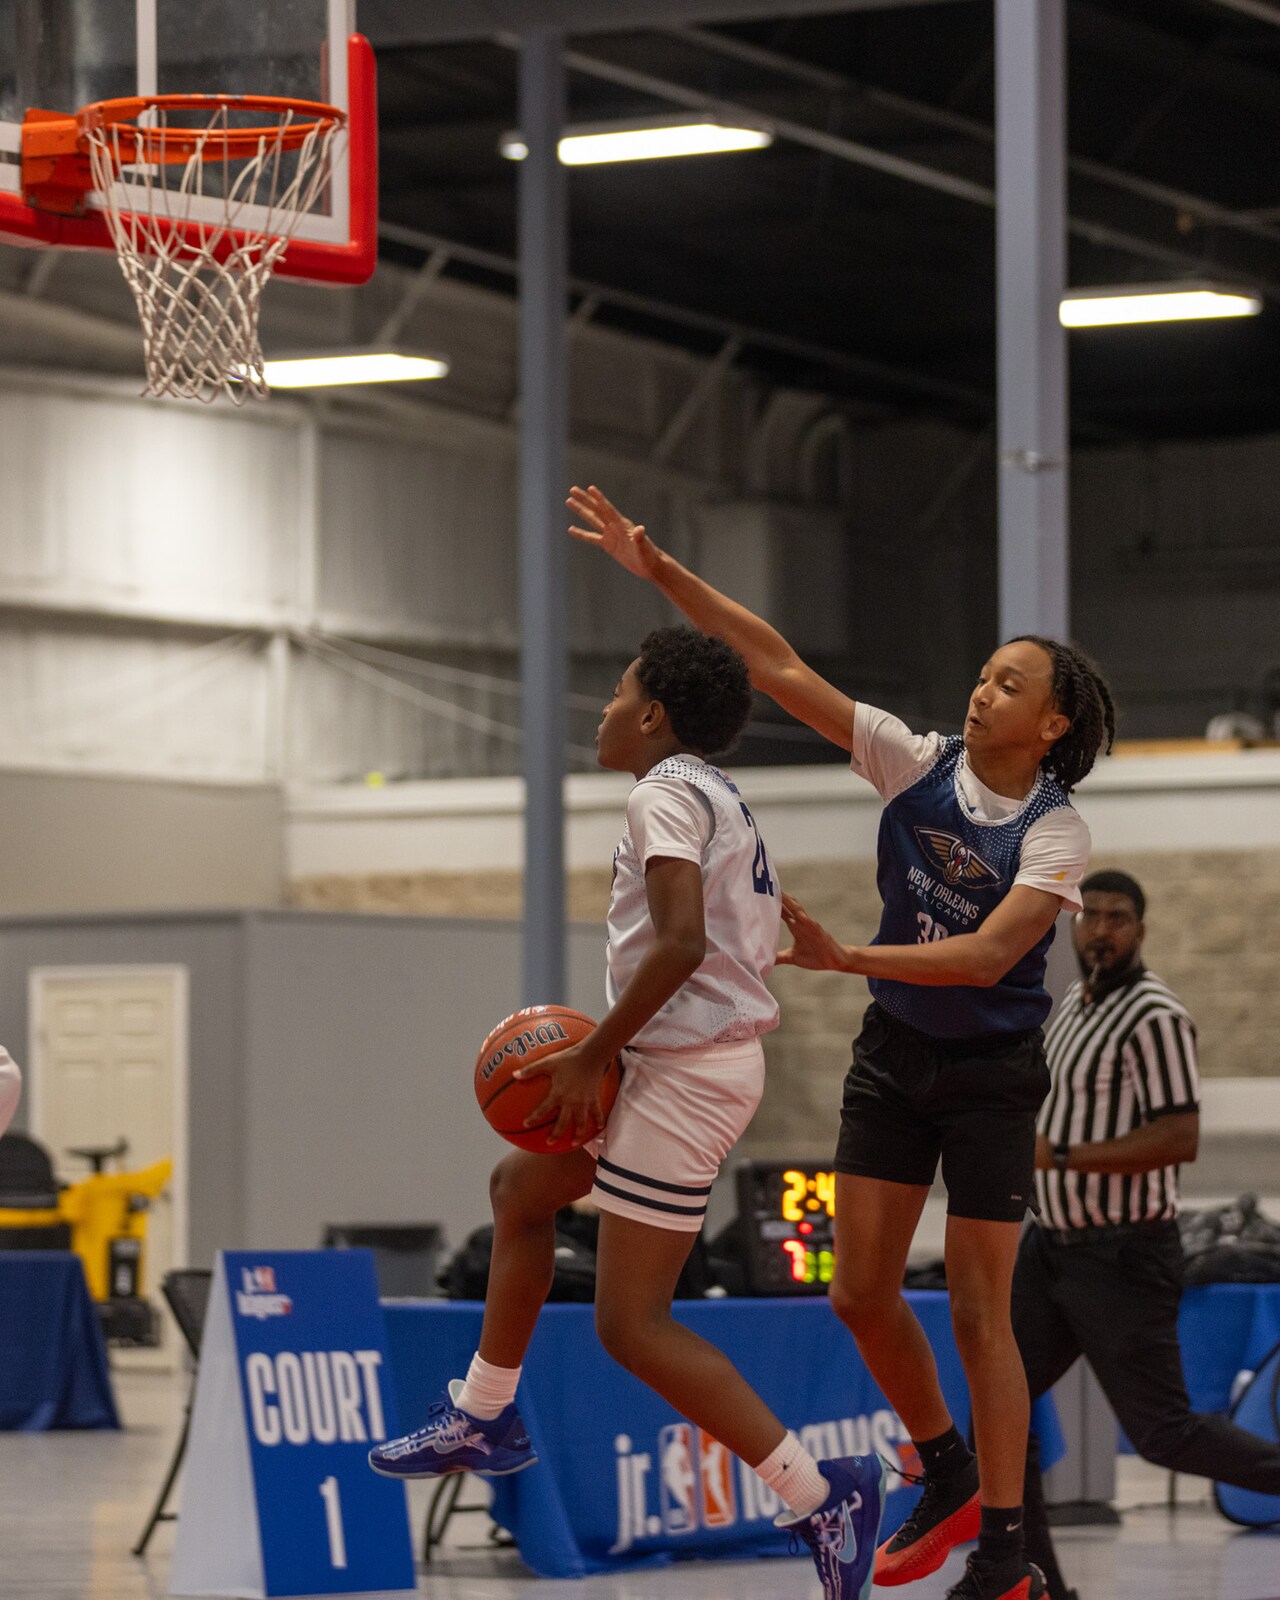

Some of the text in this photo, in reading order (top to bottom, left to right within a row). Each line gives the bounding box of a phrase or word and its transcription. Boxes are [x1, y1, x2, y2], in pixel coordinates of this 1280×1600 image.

[906, 865, 980, 920] NEW ORLEANS
[907, 884, 969, 926] PELICANS
[481, 1021, 569, 1081] Wilson
[246, 1350, 385, 1446] COURT
[319, 1476, 347, 1568] 1
[608, 1433, 661, 1555] jr.
